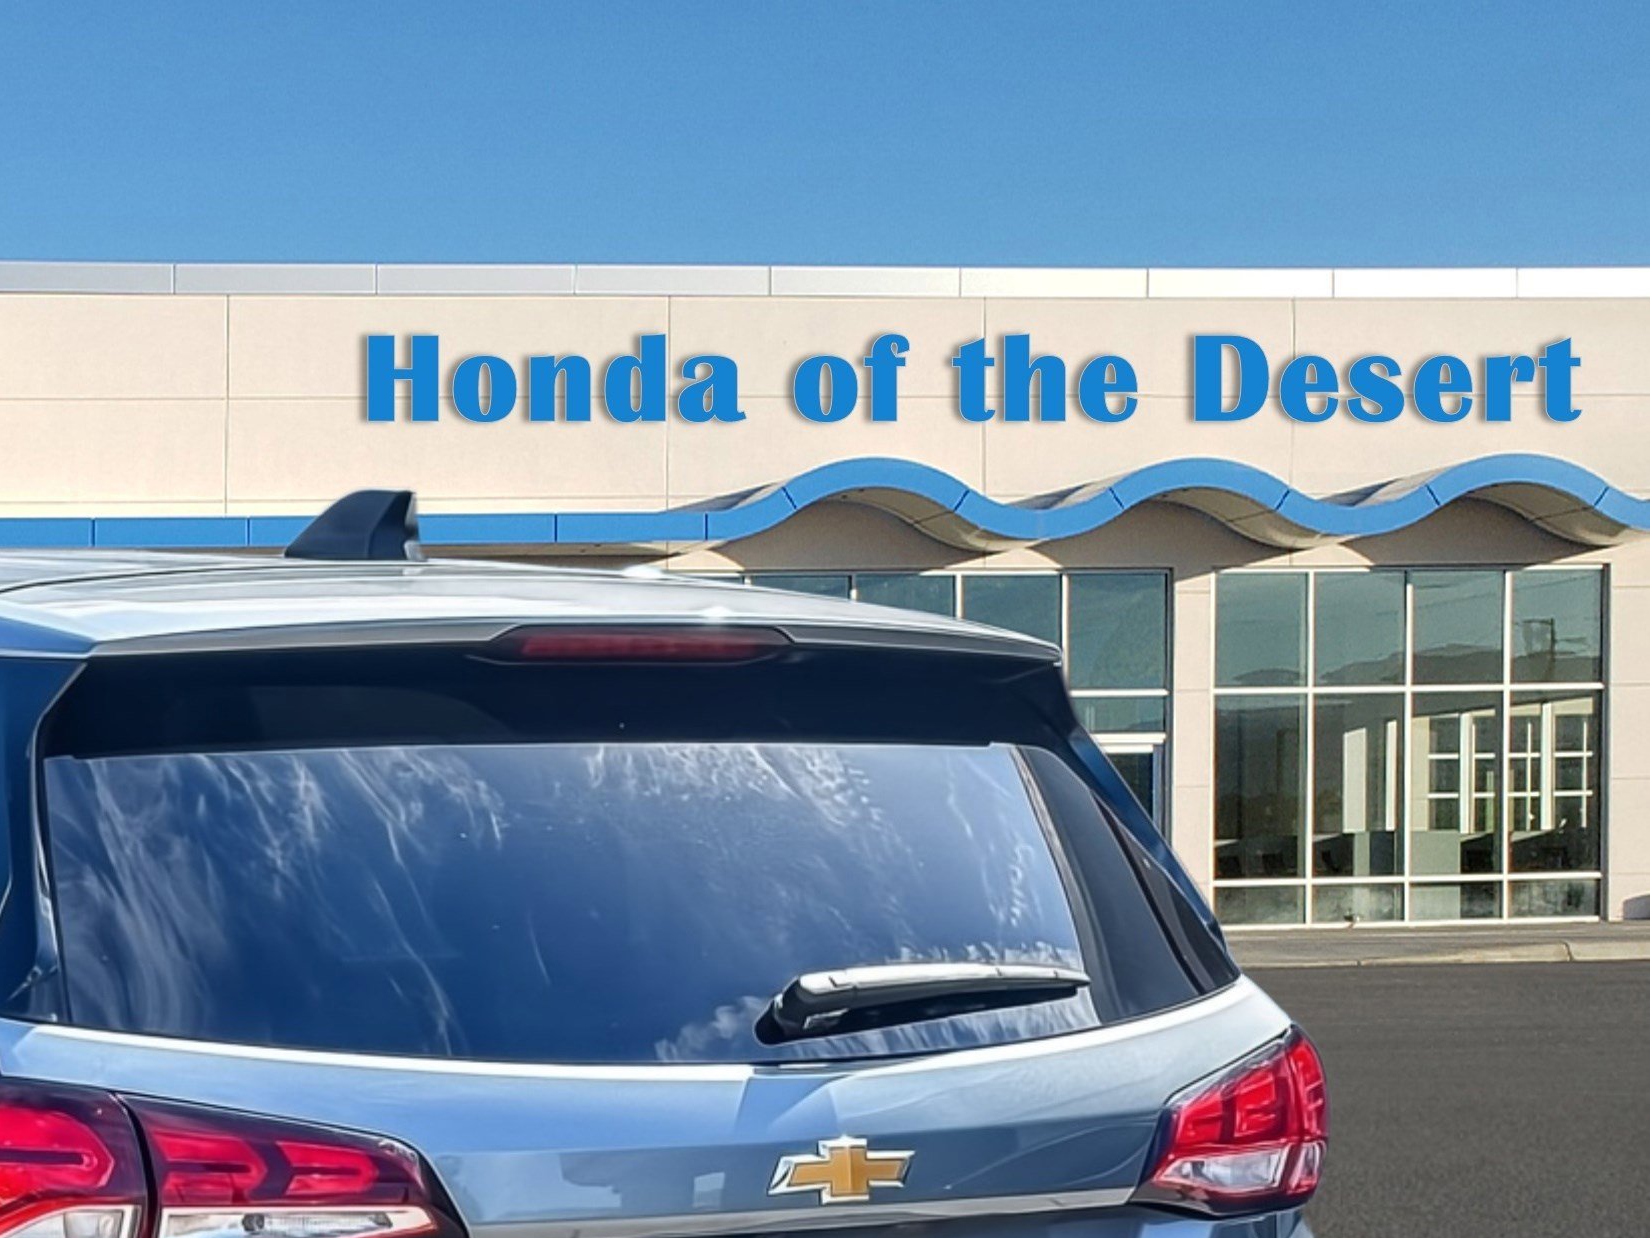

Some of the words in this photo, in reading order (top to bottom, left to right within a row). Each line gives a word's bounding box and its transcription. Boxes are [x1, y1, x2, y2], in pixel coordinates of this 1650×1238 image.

[363, 333, 746, 422] Honda
[791, 333, 909, 422] of
[953, 335, 1138, 422] the
[1191, 334, 1582, 422] Desert
